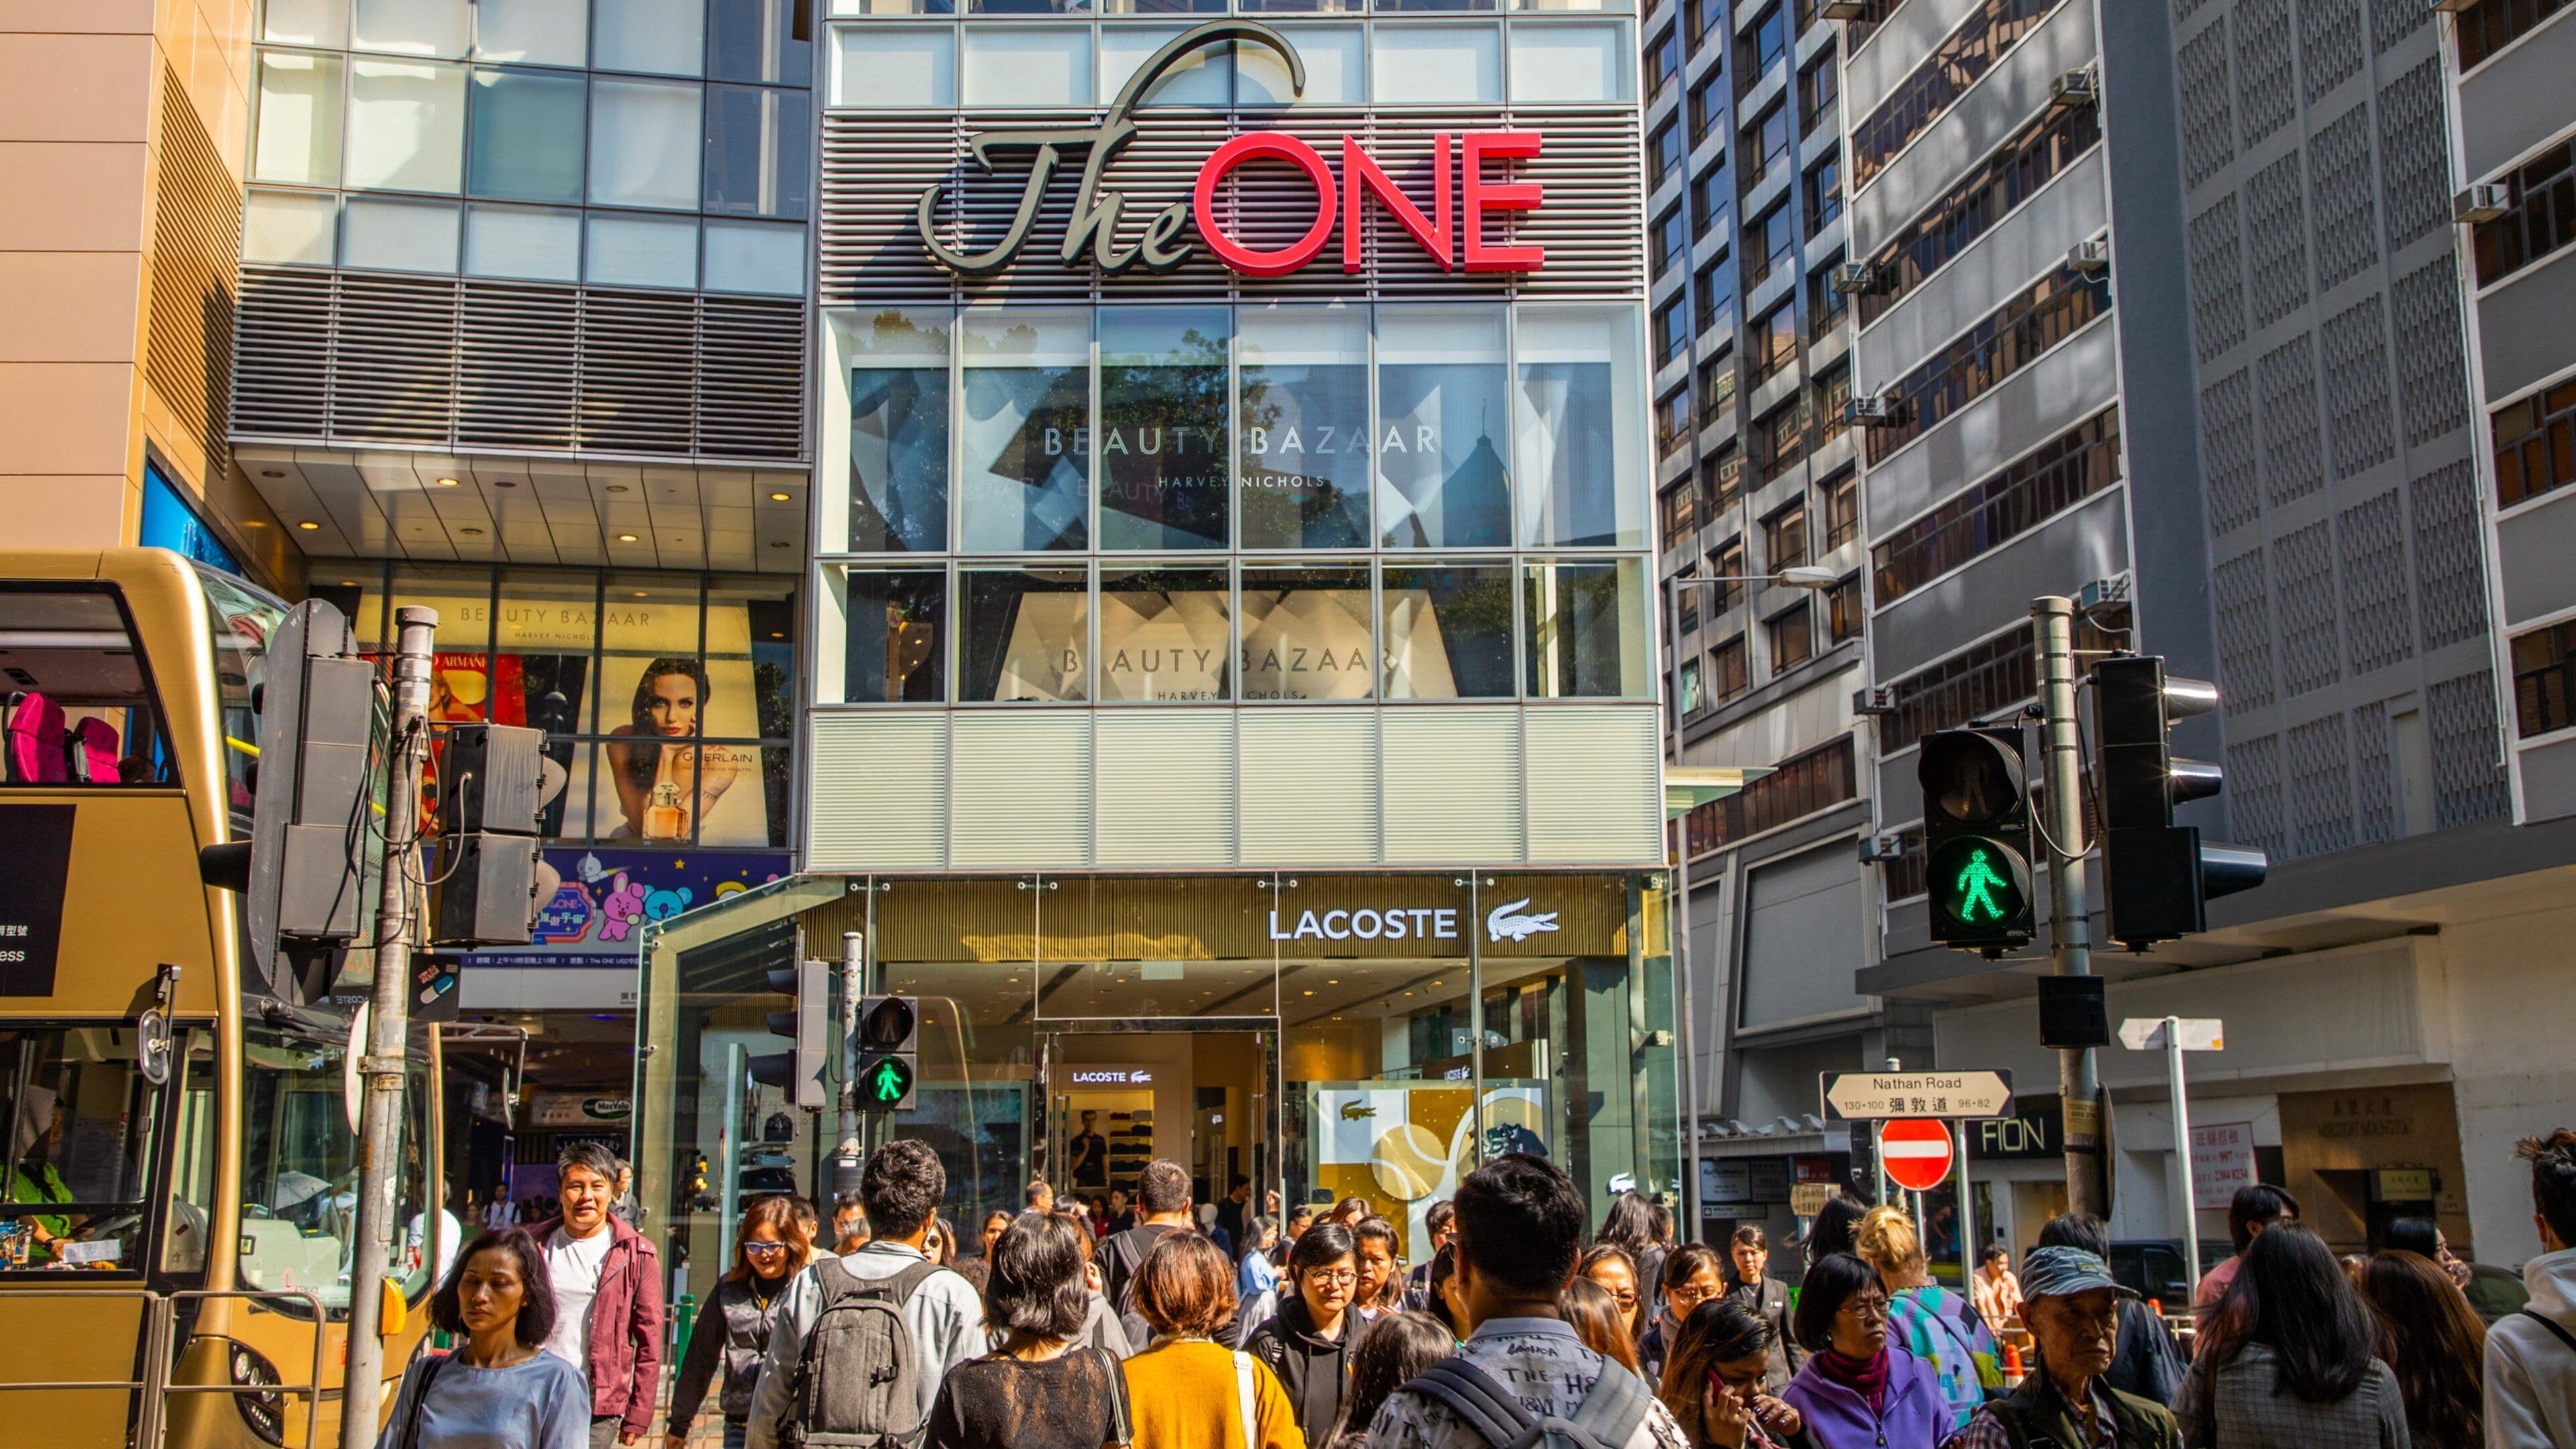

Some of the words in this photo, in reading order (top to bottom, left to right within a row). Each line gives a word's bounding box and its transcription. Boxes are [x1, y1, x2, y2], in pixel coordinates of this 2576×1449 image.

[918, 19, 1305, 276] The
[1194, 133, 1544, 276] ONE
[1044, 426, 1219, 455] BEAUTY
[1250, 426, 1436, 454] BAZAAR
[1159, 476, 1229, 488] HARVEY
[1241, 476, 1324, 487] NICHOLS
[461, 608, 547, 623] BEUTY
[561, 610, 649, 626] BAAAR
[1063, 648, 1212, 672] BAUTY
[1158, 692, 1218, 700] HARVEY
[683, 752, 752, 763] GERLAIN
[1269, 909, 1457, 939] LACOSTE
[1073, 1073, 1126, 1081] LACOSTE
[1873, 1077, 1922, 1089] Nathan
[1926, 1077, 1962, 1089] Road
[1889, 1097, 1948, 1113] 彌敦道
[1982, 1118, 2045, 1152] FION
